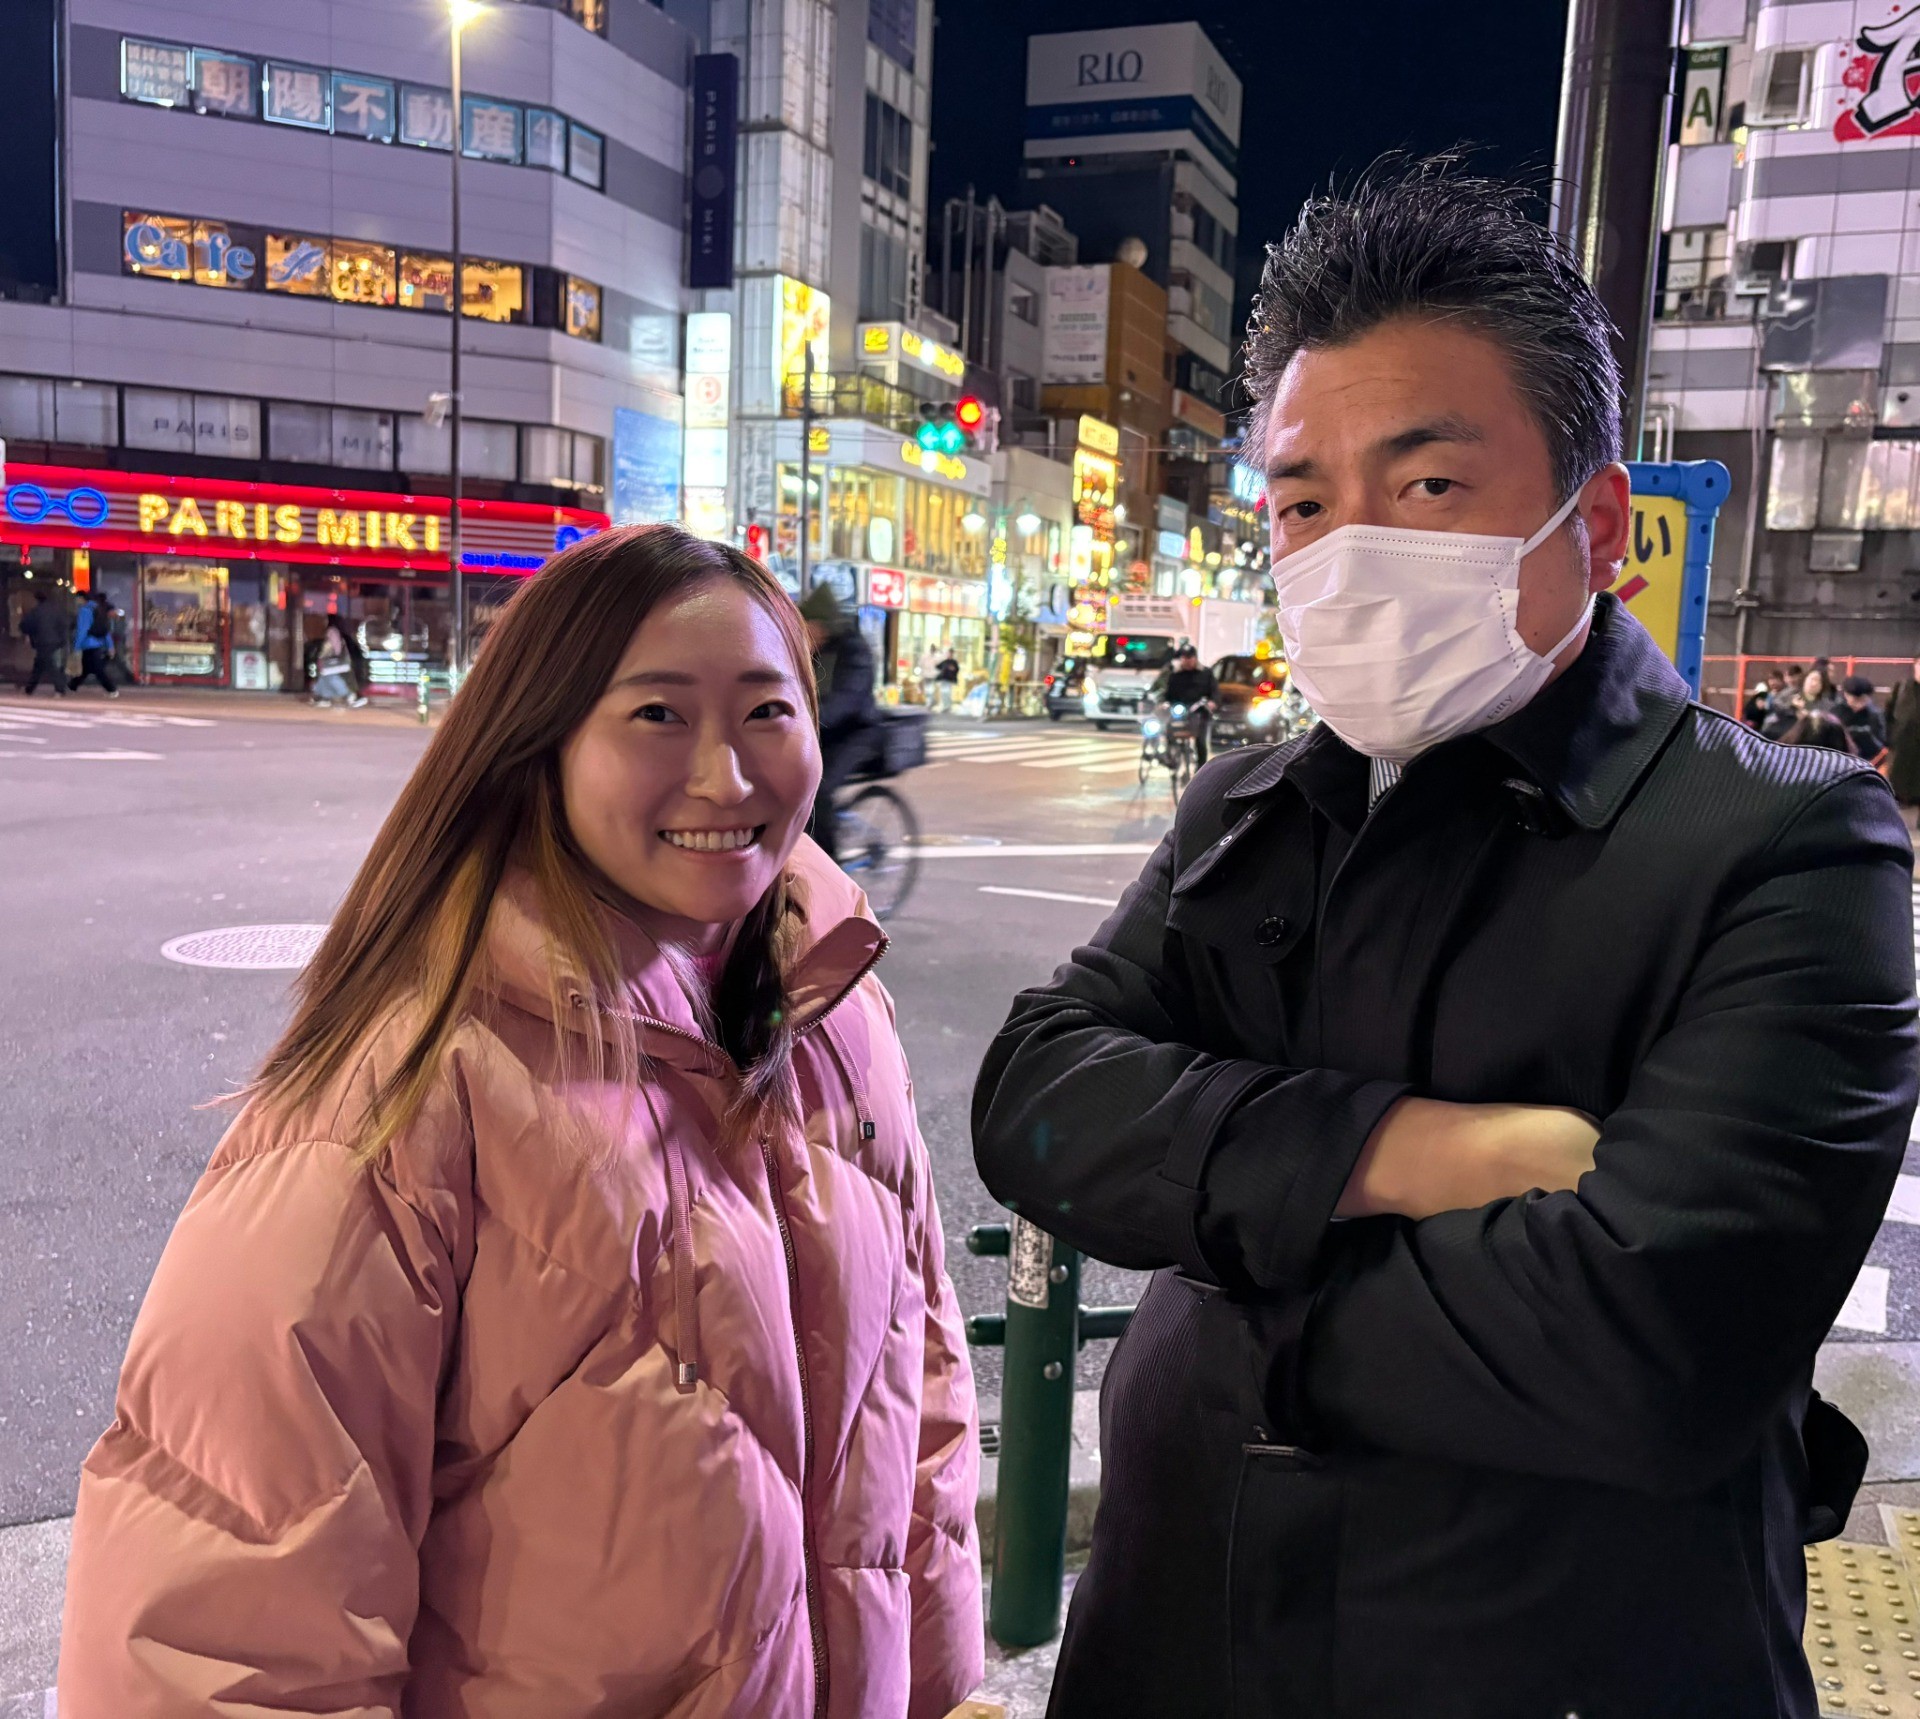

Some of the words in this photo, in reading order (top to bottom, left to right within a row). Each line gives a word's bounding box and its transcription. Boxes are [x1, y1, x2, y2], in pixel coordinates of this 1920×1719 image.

[1078, 50, 1144, 87] RIO
[201, 59, 516, 156] 朝陽不動産
[703, 90, 717, 156] PARIS
[1686, 86, 1713, 129] A
[125, 222, 256, 280] Cafe
[702, 208, 714, 255] MIKI
[154, 416, 249, 442] PARIS
[139, 494, 302, 543] PARIS
[317, 508, 440, 552] MIKI
[1623, 506, 1672, 566] い
